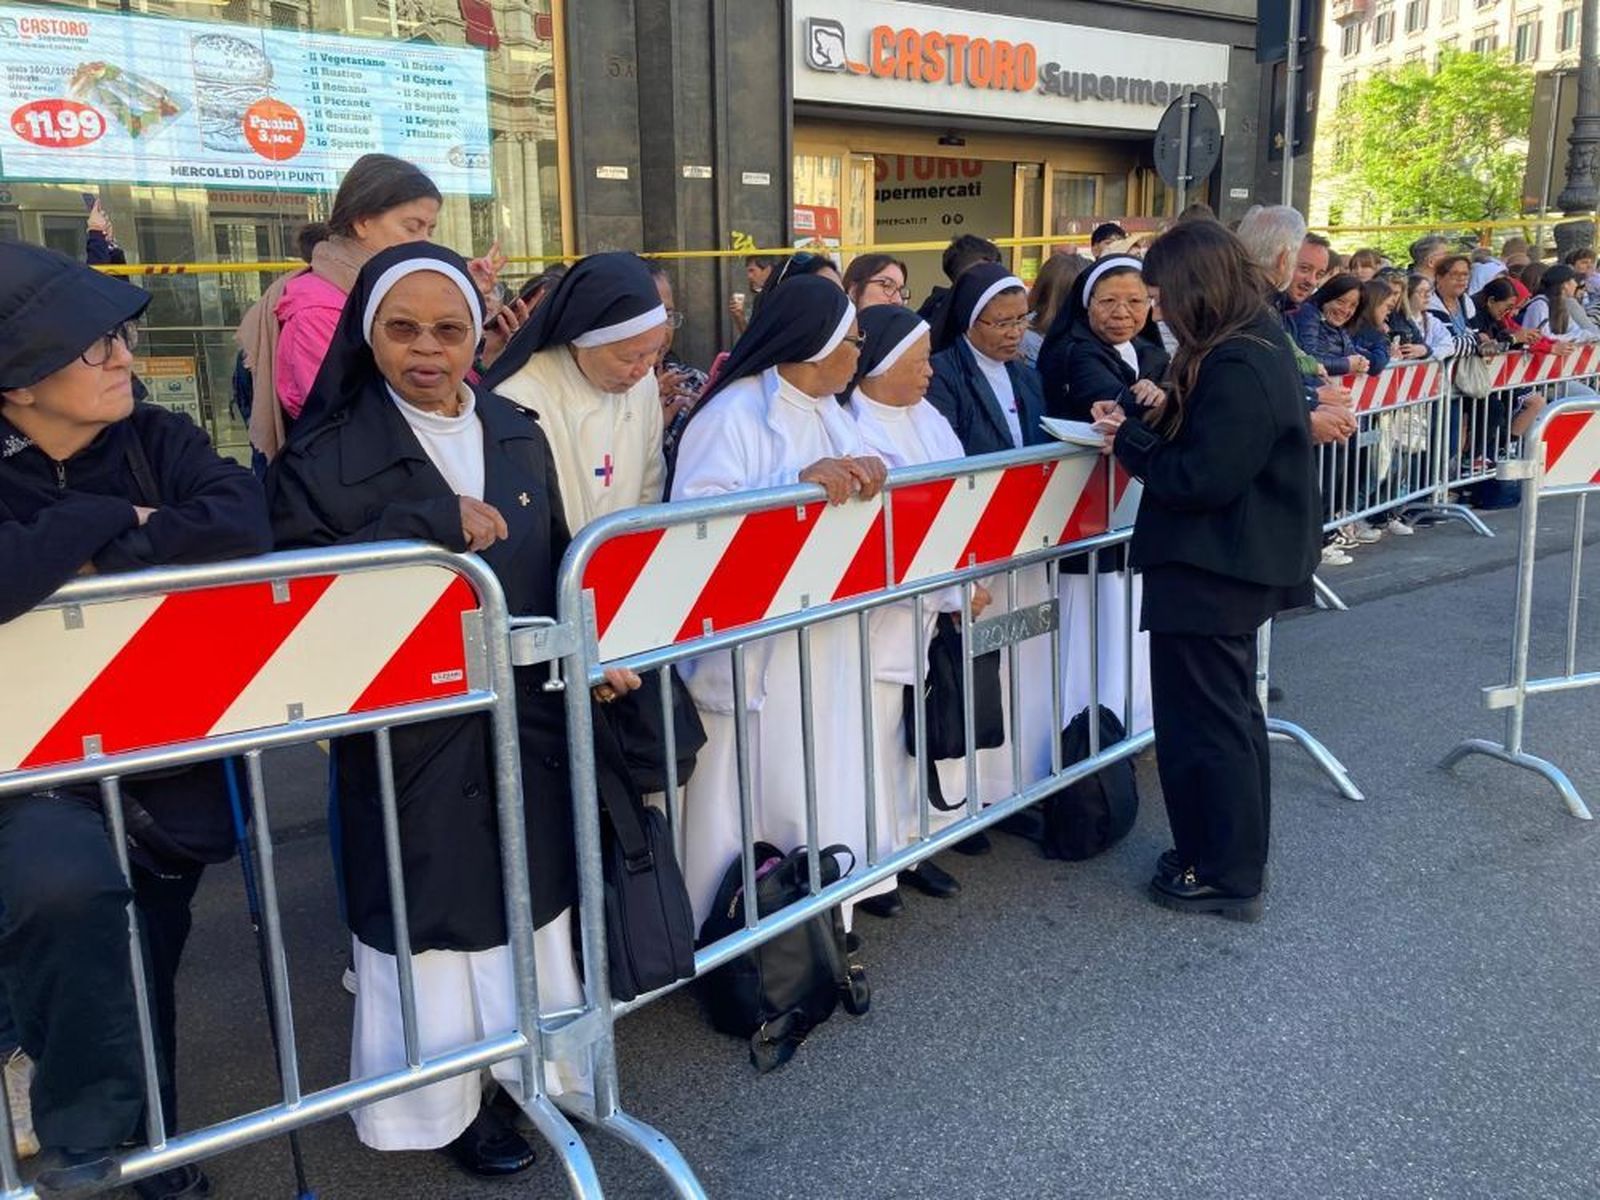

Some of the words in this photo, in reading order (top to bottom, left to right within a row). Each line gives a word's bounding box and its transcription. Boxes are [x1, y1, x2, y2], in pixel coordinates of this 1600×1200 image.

[20, 18, 88, 36] CASTORO
[320, 53, 386, 66] Vegetariano
[871, 25, 1037, 92] CASTORO
[171, 165, 245, 179] MERCOLEDÌ
[248, 168, 286, 181] DOPPI
[289, 170, 325, 182] PUNTI
